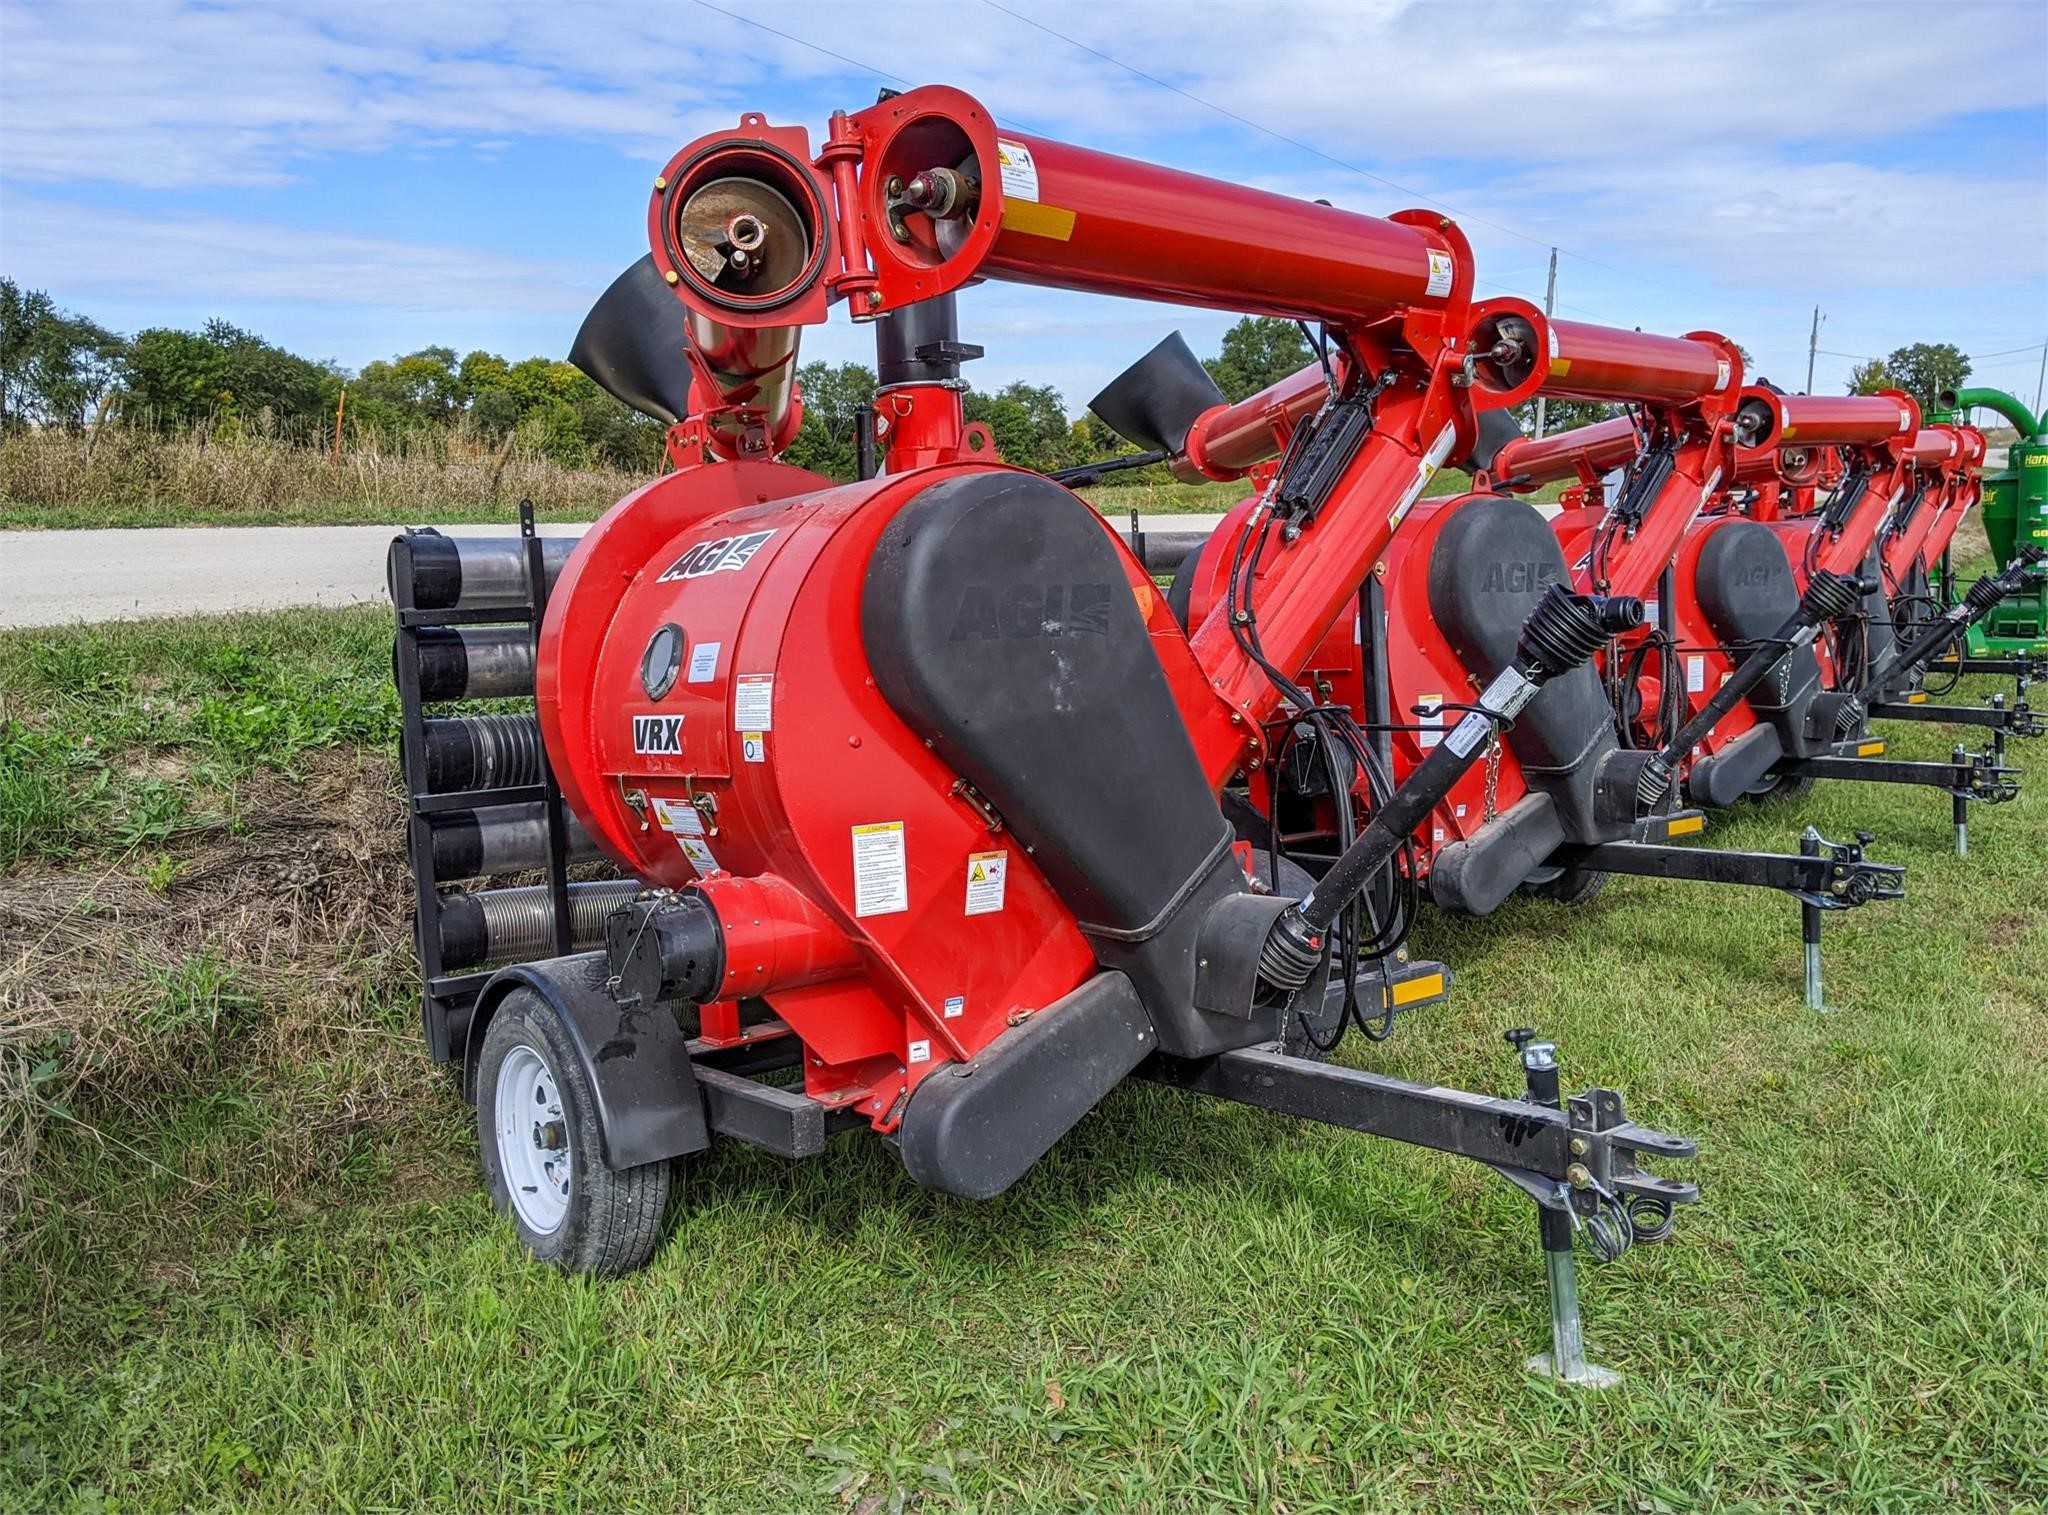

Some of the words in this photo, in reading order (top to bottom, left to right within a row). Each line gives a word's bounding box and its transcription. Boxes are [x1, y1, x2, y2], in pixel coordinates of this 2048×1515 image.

[2025, 455, 2048, 465] Han
[661, 538, 743, 578] AGI
[1481, 562, 1535, 593] AGI
[951, 586, 1065, 640] AGI
[635, 718, 681, 751] VRX
